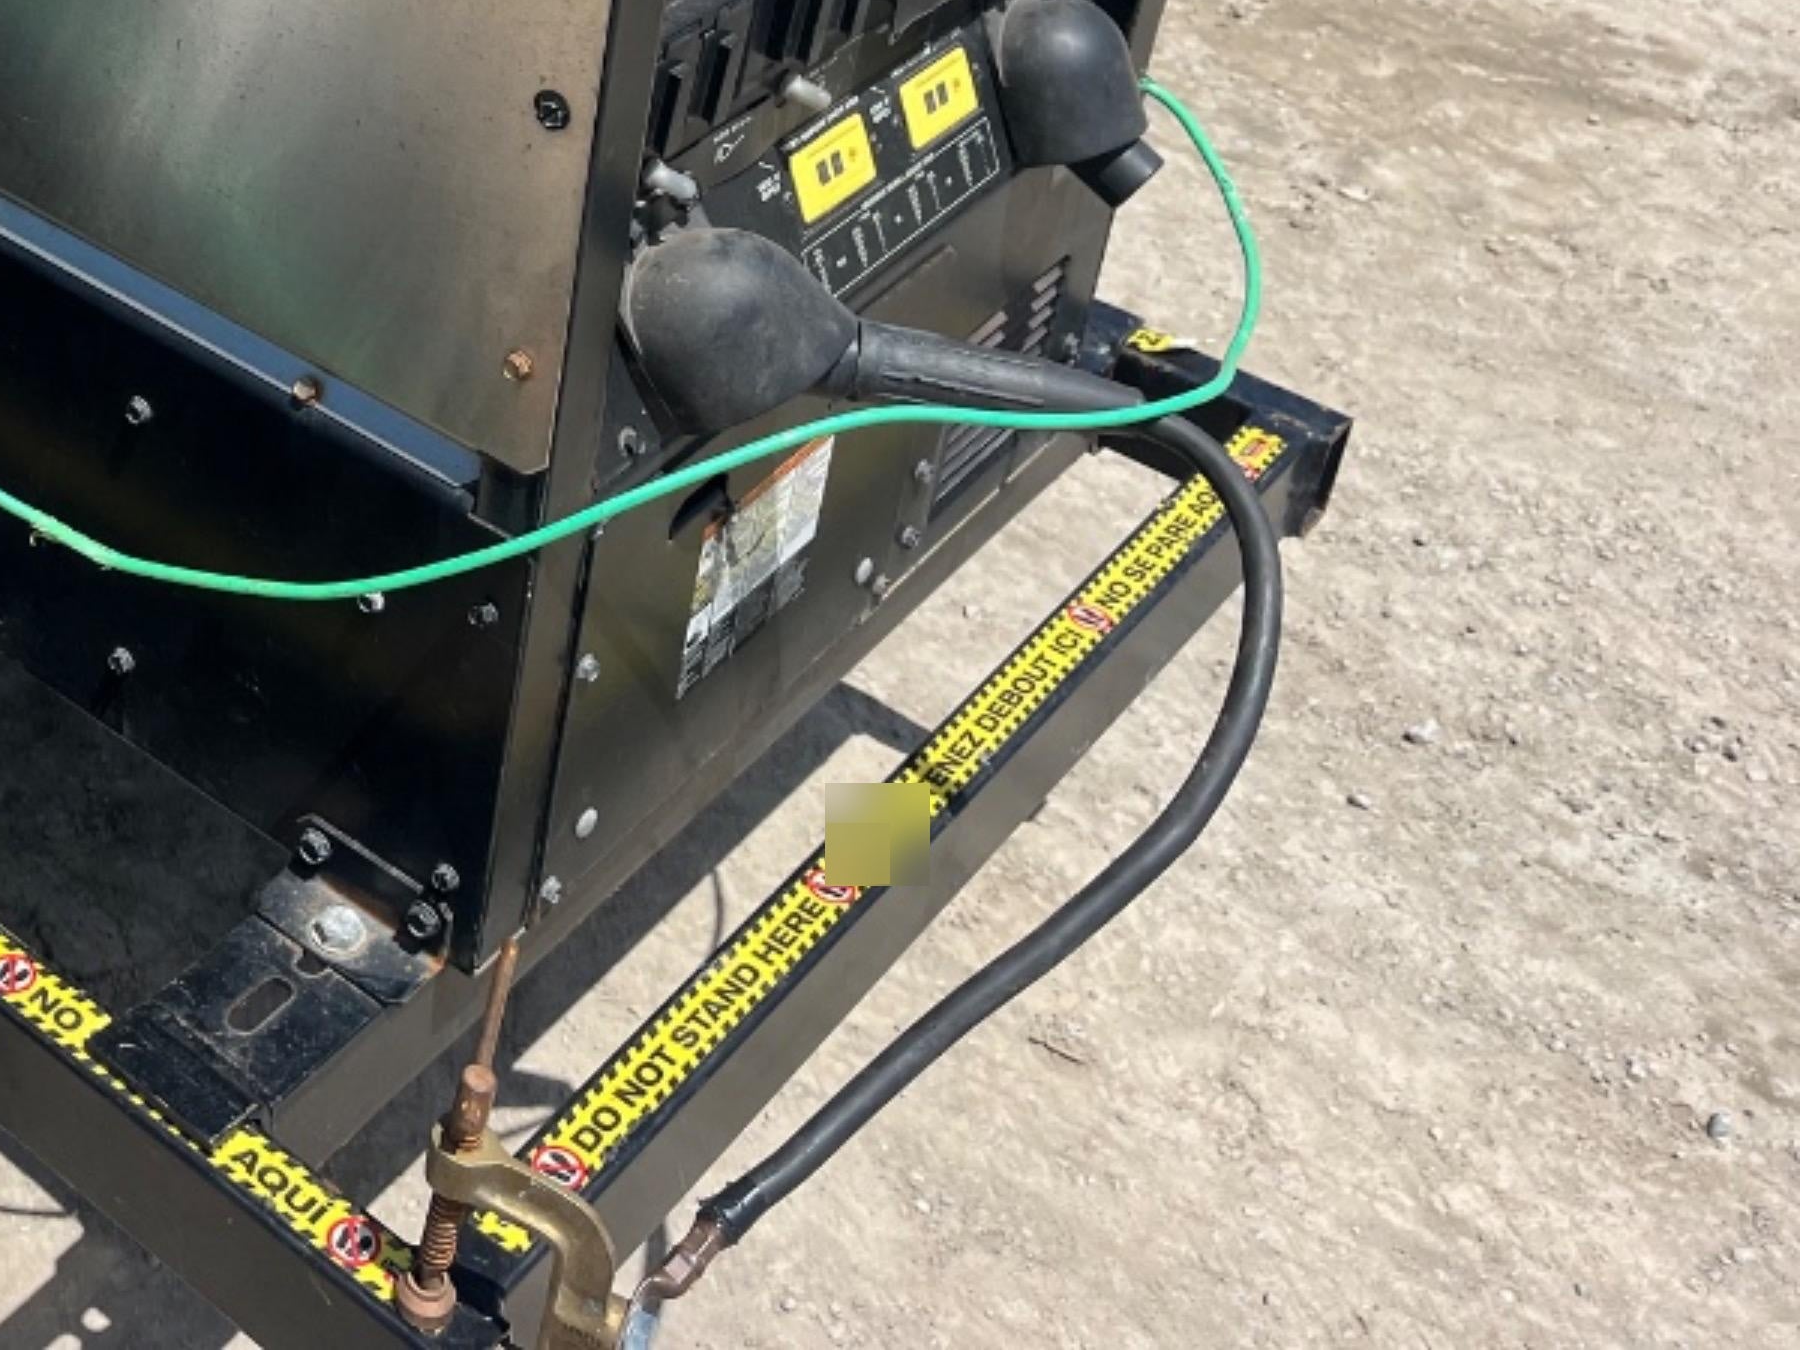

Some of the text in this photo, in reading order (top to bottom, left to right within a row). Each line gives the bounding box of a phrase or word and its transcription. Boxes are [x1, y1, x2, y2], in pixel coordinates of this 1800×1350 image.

[974, 653, 1058, 733] DEBOUT
[29, 986, 83, 1032] NO
[570, 897, 827, 1154] DO NOT STAND HERE
